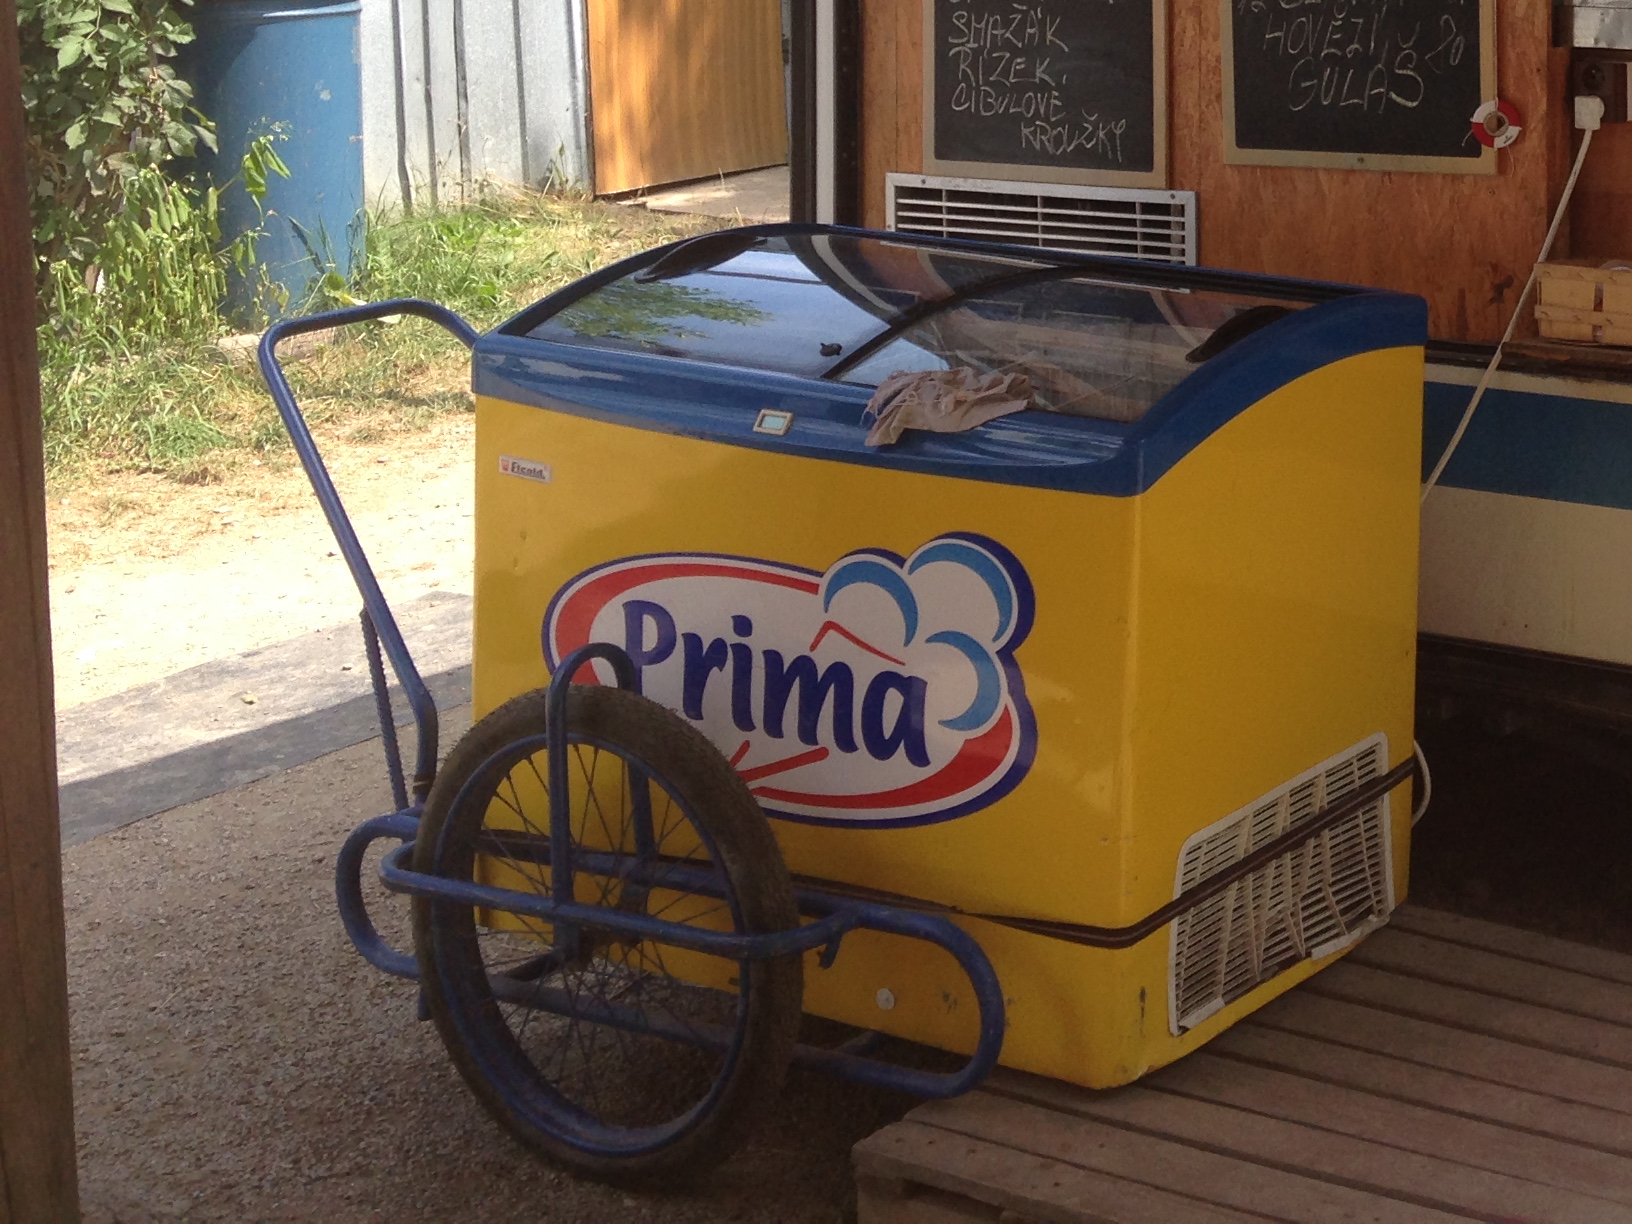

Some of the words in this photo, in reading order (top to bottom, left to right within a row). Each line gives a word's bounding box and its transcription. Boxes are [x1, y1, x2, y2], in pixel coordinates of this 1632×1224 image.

[949, 3, 1069, 53] SMAŽÁK
[1289, 24, 1424, 114] GULÁŠ
[1021, 109, 1126, 163] KROUŽKY
[622, 599, 931, 767] Prima
